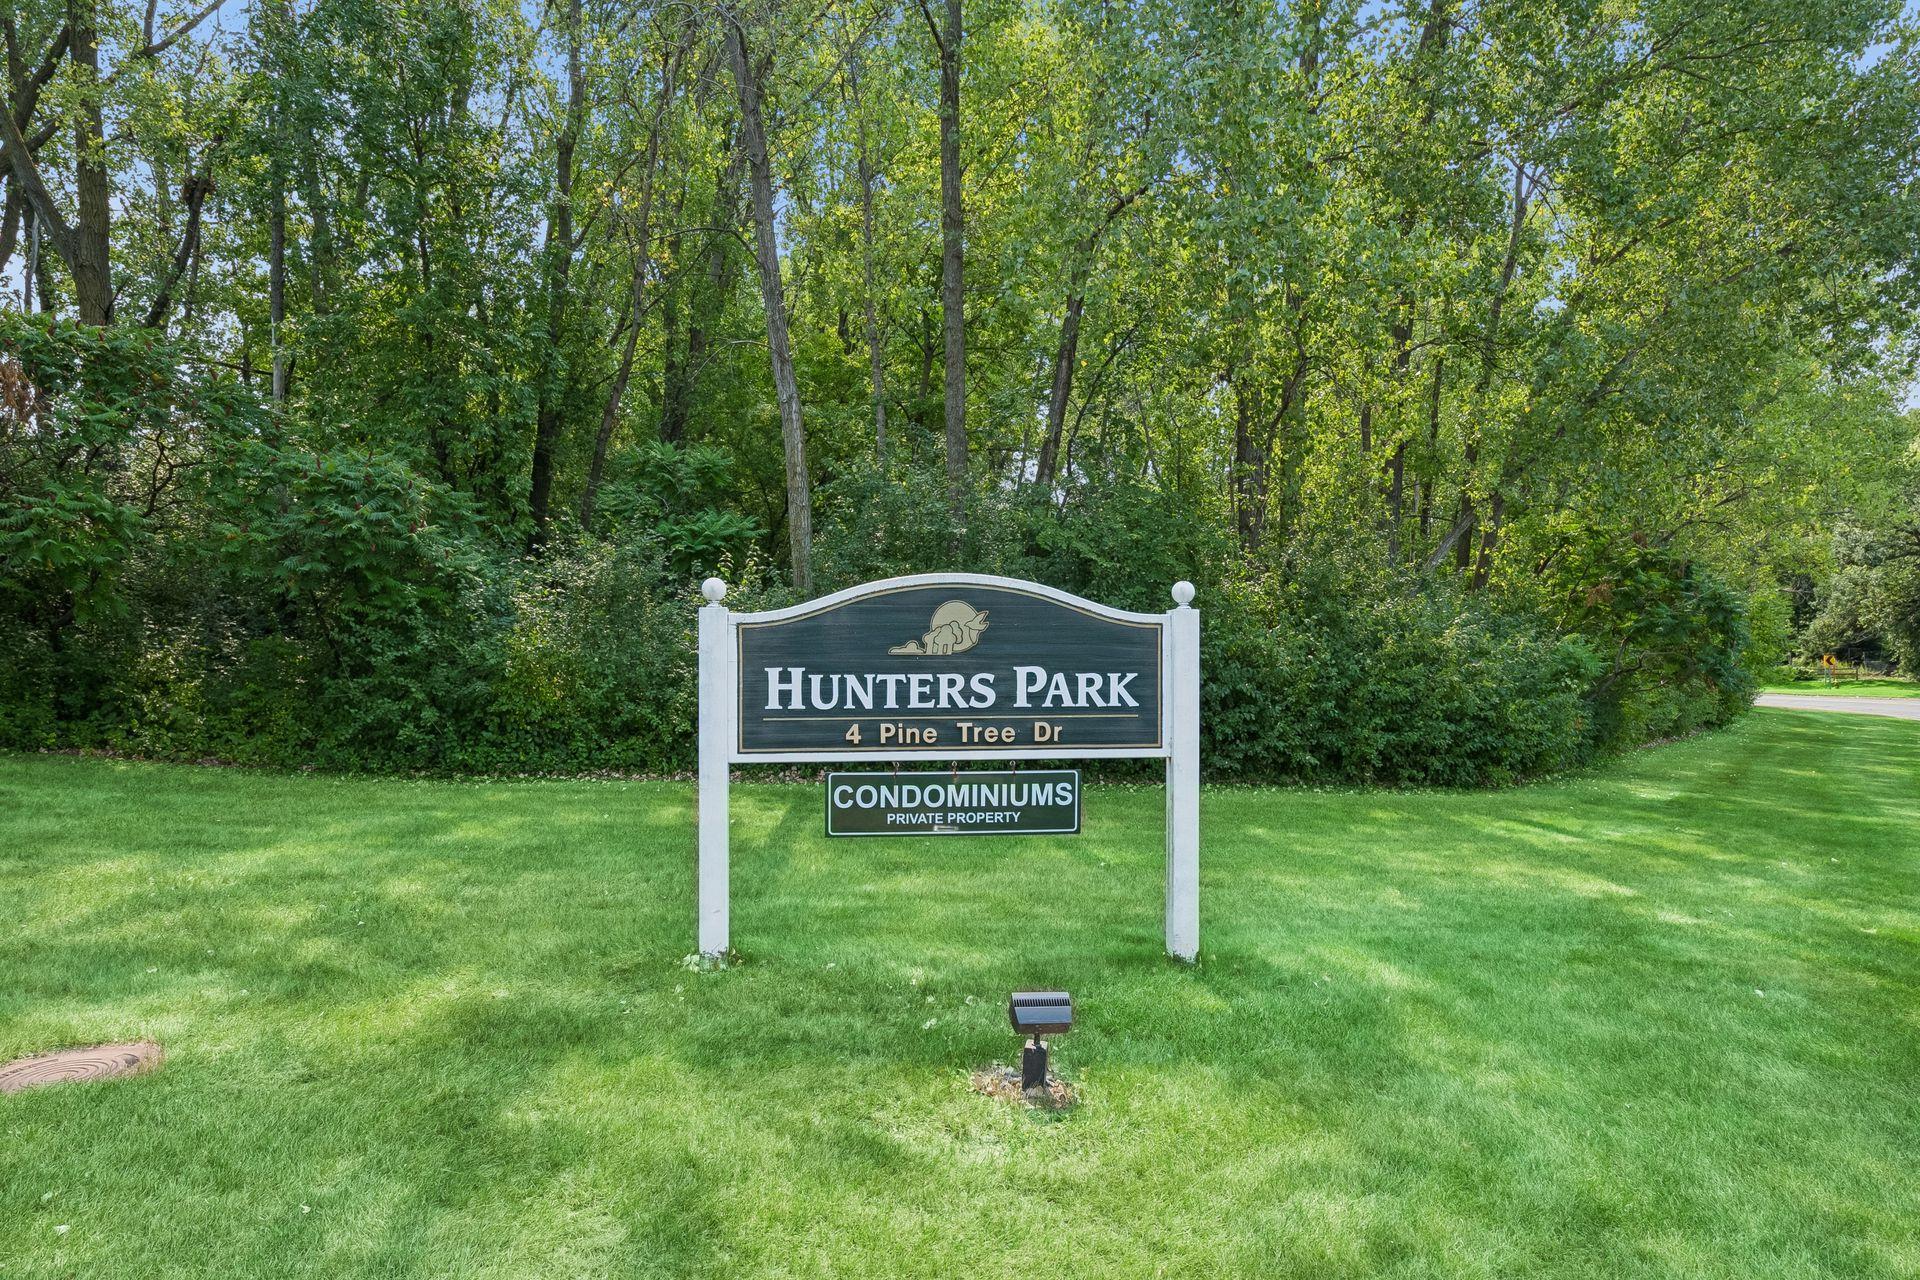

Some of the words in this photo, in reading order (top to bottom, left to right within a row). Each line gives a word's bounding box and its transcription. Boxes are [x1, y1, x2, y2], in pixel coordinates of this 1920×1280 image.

[845, 724, 862, 744] 4
[880, 722, 938, 744] Pine
[957, 721, 1016, 743] Tree
[1033, 720, 1063, 742] Dr
[833, 782, 1073, 809] CONDOMINIUMS
[887, 812, 944, 825] PRIVATE
[947, 811, 1021, 824] PROPERTY
